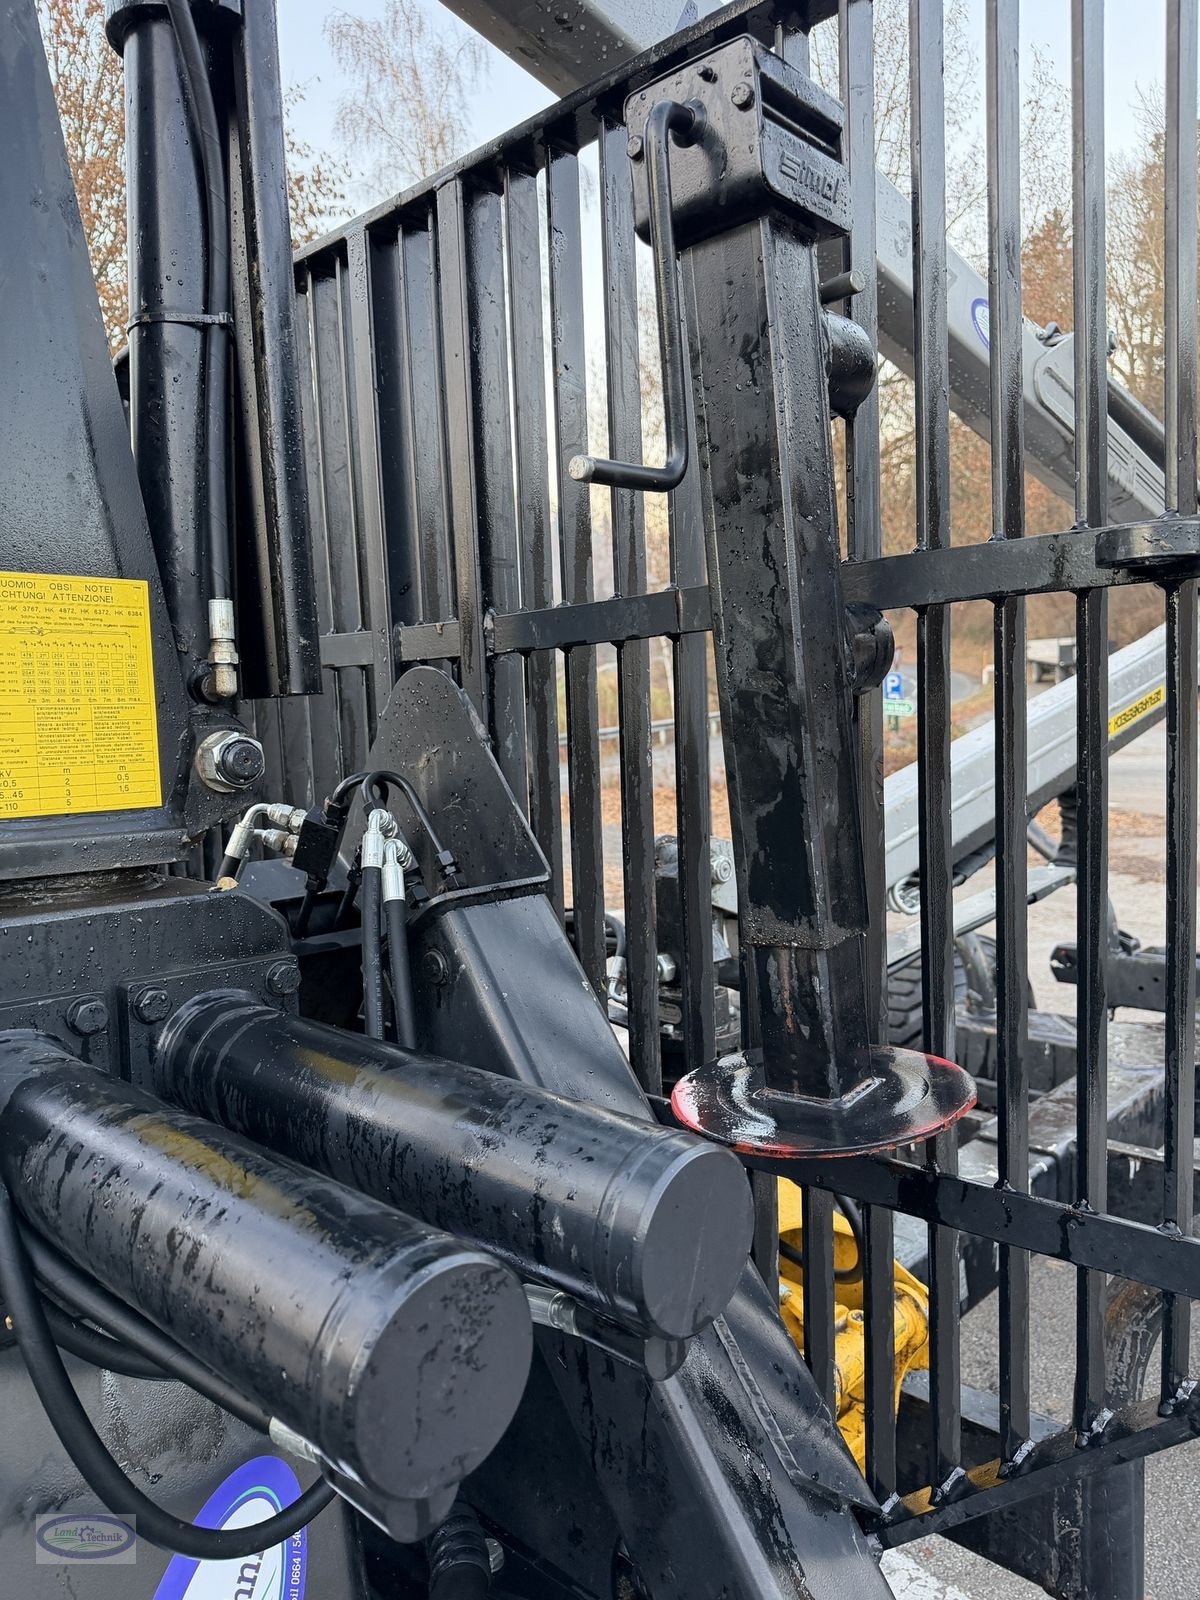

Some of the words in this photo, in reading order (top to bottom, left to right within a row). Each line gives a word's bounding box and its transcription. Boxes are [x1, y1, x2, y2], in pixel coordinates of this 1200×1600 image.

[49, 582, 73, 591] OBS!
[84, 584, 113, 593] NOTE!
[0, 590, 46, 600] CHTUNG!
[52, 593, 114, 603] ATTENZIONE!
[886, 675, 899, 693] P
[65, 778, 70, 786] 2
[291, 1557, 302, 1585] 0664
